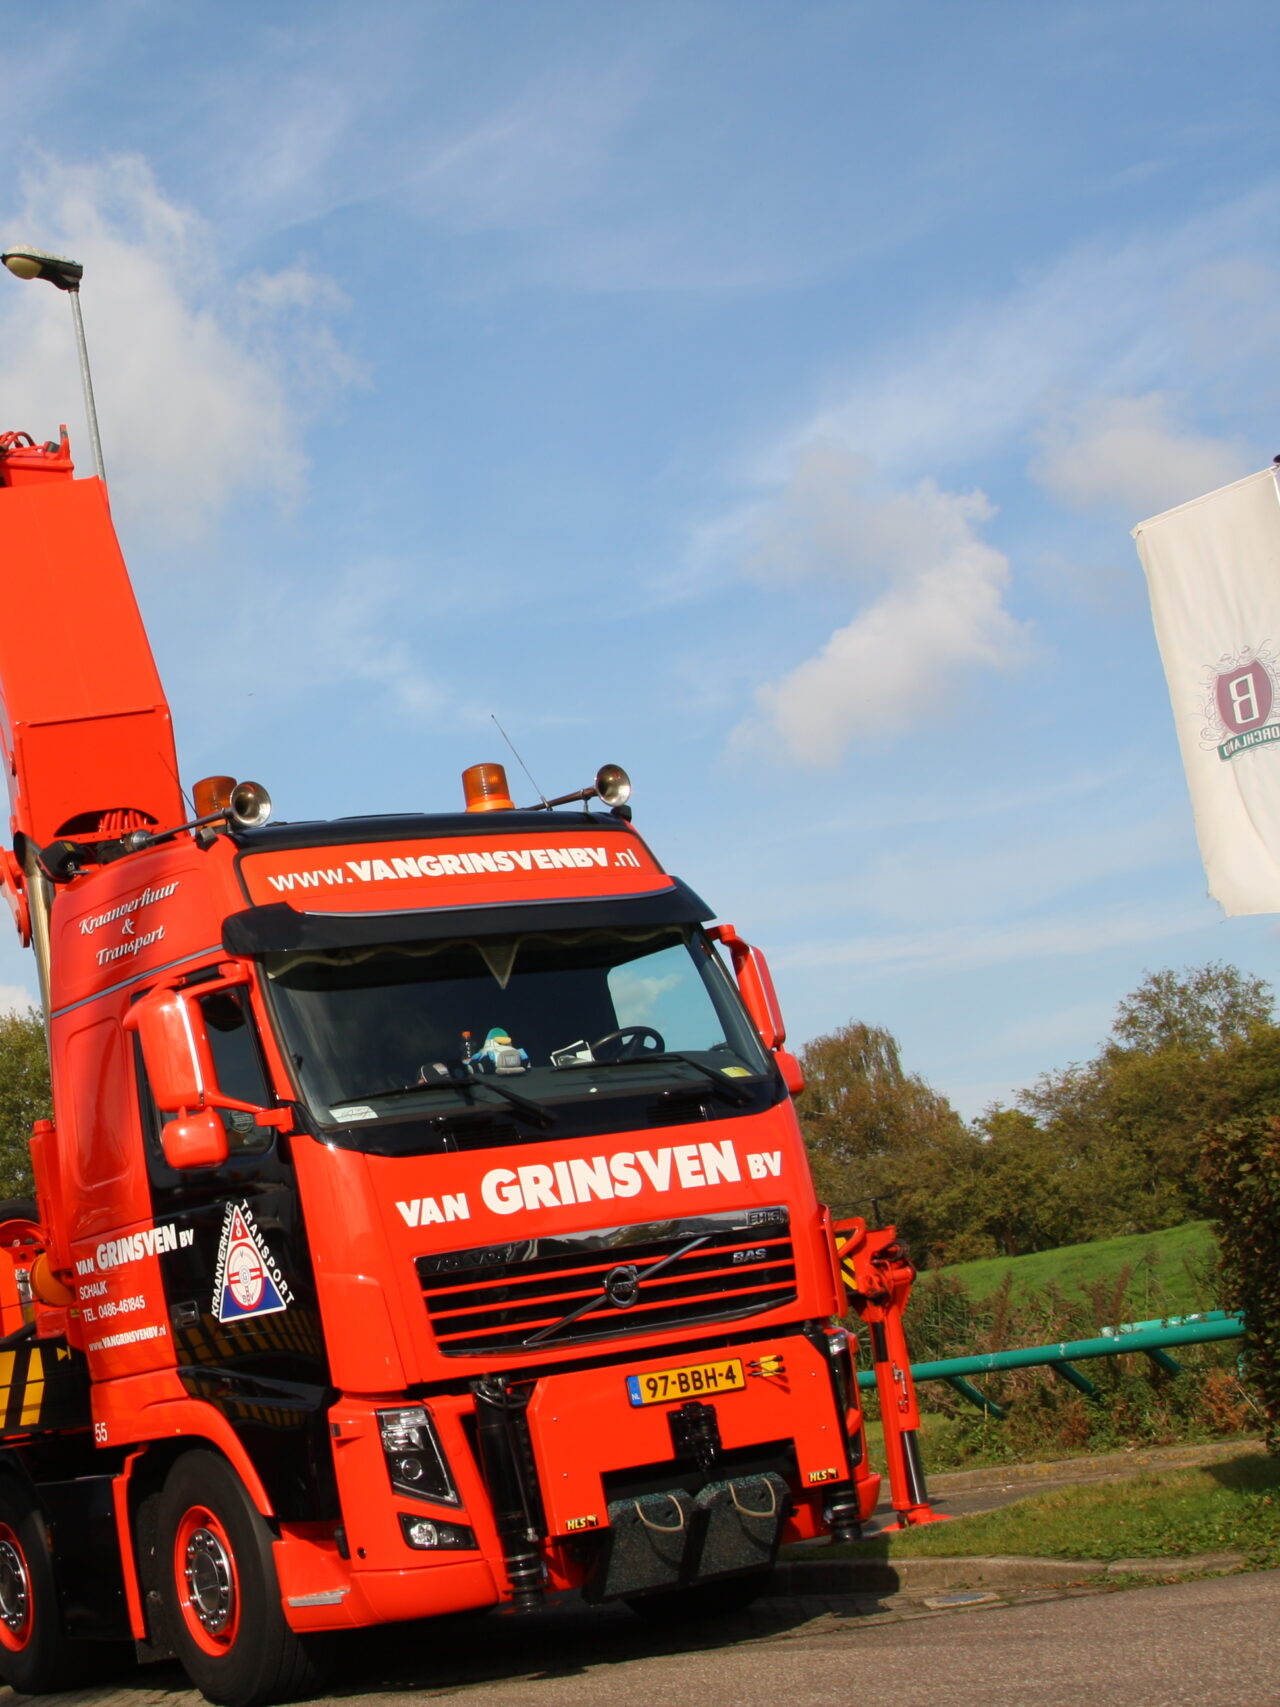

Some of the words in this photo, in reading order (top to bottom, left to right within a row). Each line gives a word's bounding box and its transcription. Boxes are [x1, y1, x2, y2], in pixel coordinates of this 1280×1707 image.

[267, 847, 641, 892] www.VANGRINSVENBV.nl
[79, 881, 180, 935] Kraanverhuur
[121, 918, 136, 935] &
[95, 925, 166, 966] Transport
[395, 1192, 471, 1228] VAN
[480, 1139, 741, 1215] GRINSVEN
[747, 1151, 782, 1180] BV
[76, 1257, 96, 1276] VAN
[96, 1223, 178, 1271] GRINSVEN
[179, 1228, 194, 1248] BV
[211, 1200, 234, 1318] KRAANVERHUUR
[240, 1198, 295, 1304] TRANSPORT
[733, 1248, 767, 1264] BAS
[98, 1295, 146, 1319] 0486-461845
[88, 1324, 167, 1352] www.VANGRINSVENBV.nl
[631, 1393, 641, 1401] NL
[645, 1364, 737, 1399] 97-BBH-4
[94, 1422, 108, 1442] 55
[808, 1470, 828, 1482] HLS
[566, 1518, 587, 1531] HLS
